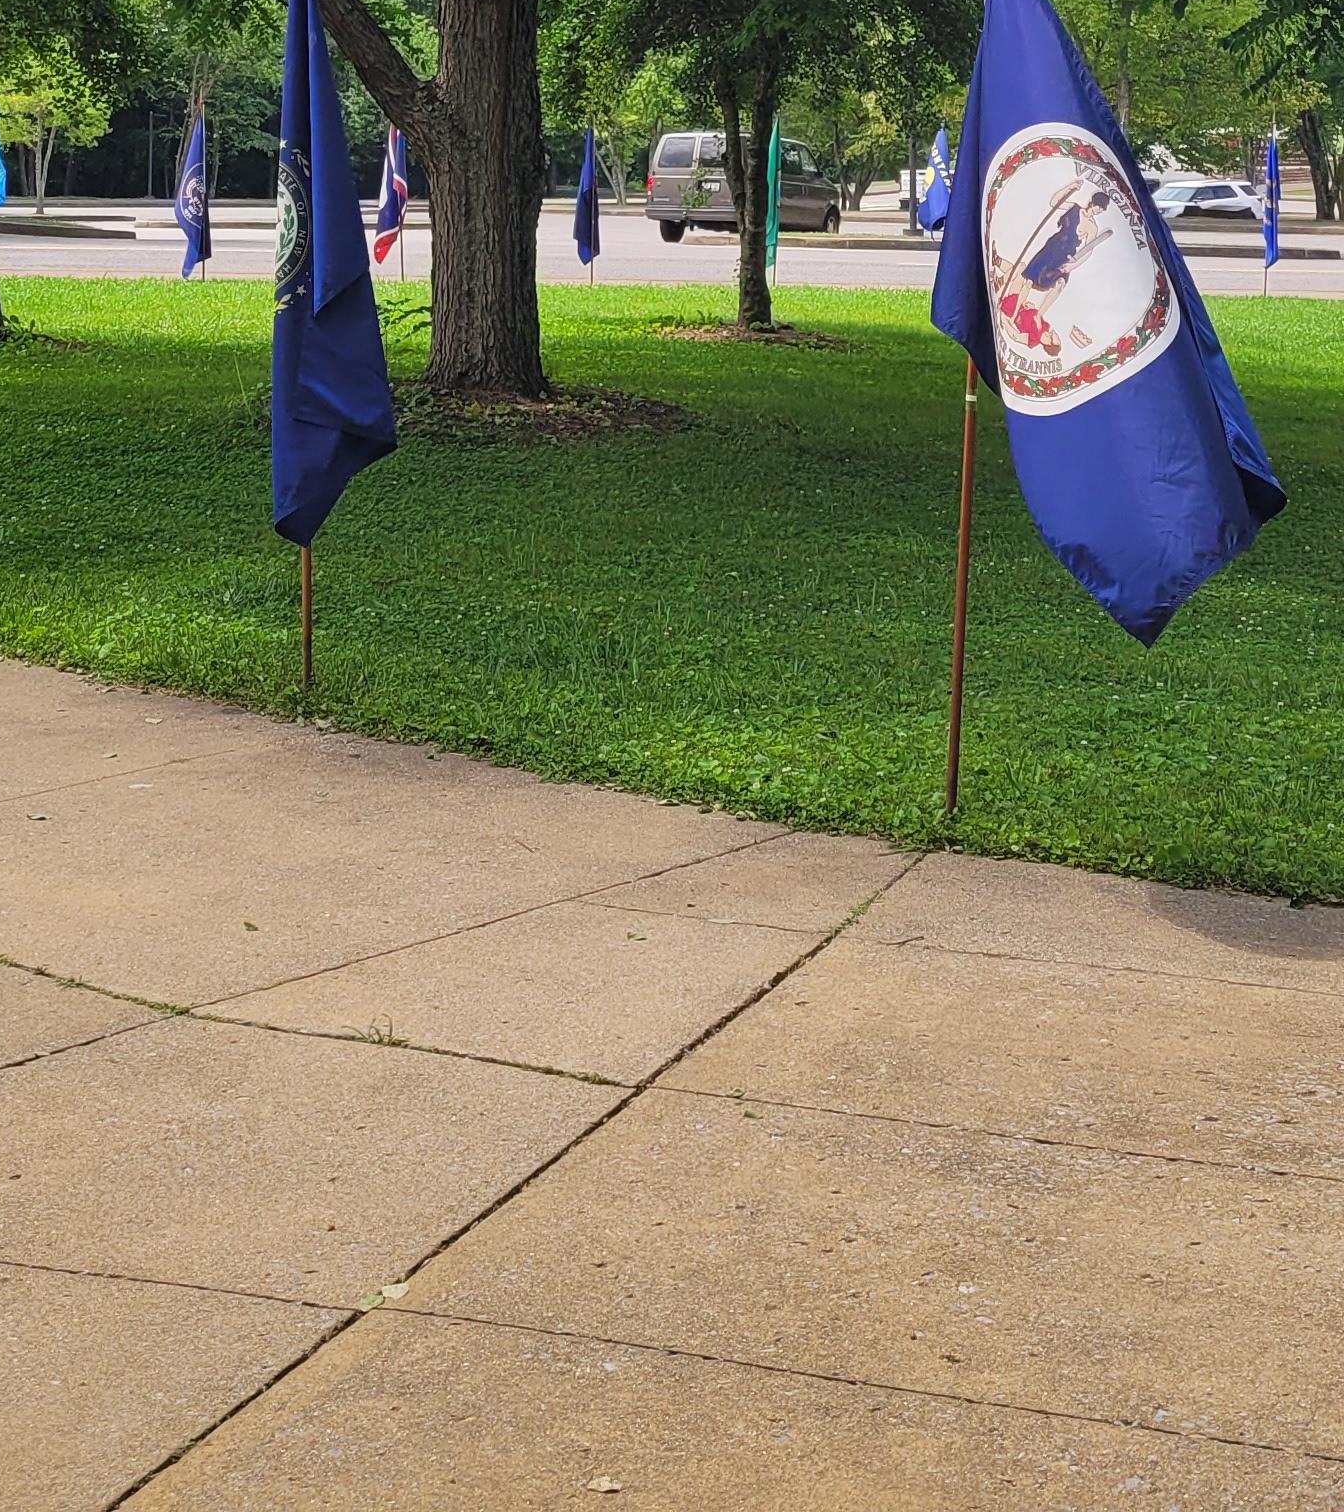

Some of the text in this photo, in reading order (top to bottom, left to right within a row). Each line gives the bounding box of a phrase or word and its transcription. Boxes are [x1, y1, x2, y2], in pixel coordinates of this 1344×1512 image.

[296, 201, 305, 216] OF
[1073, 161, 1148, 250] VIRGINIA
[294, 229, 307, 257] NEW
[1007, 347, 1063, 375] TYRANNIS
